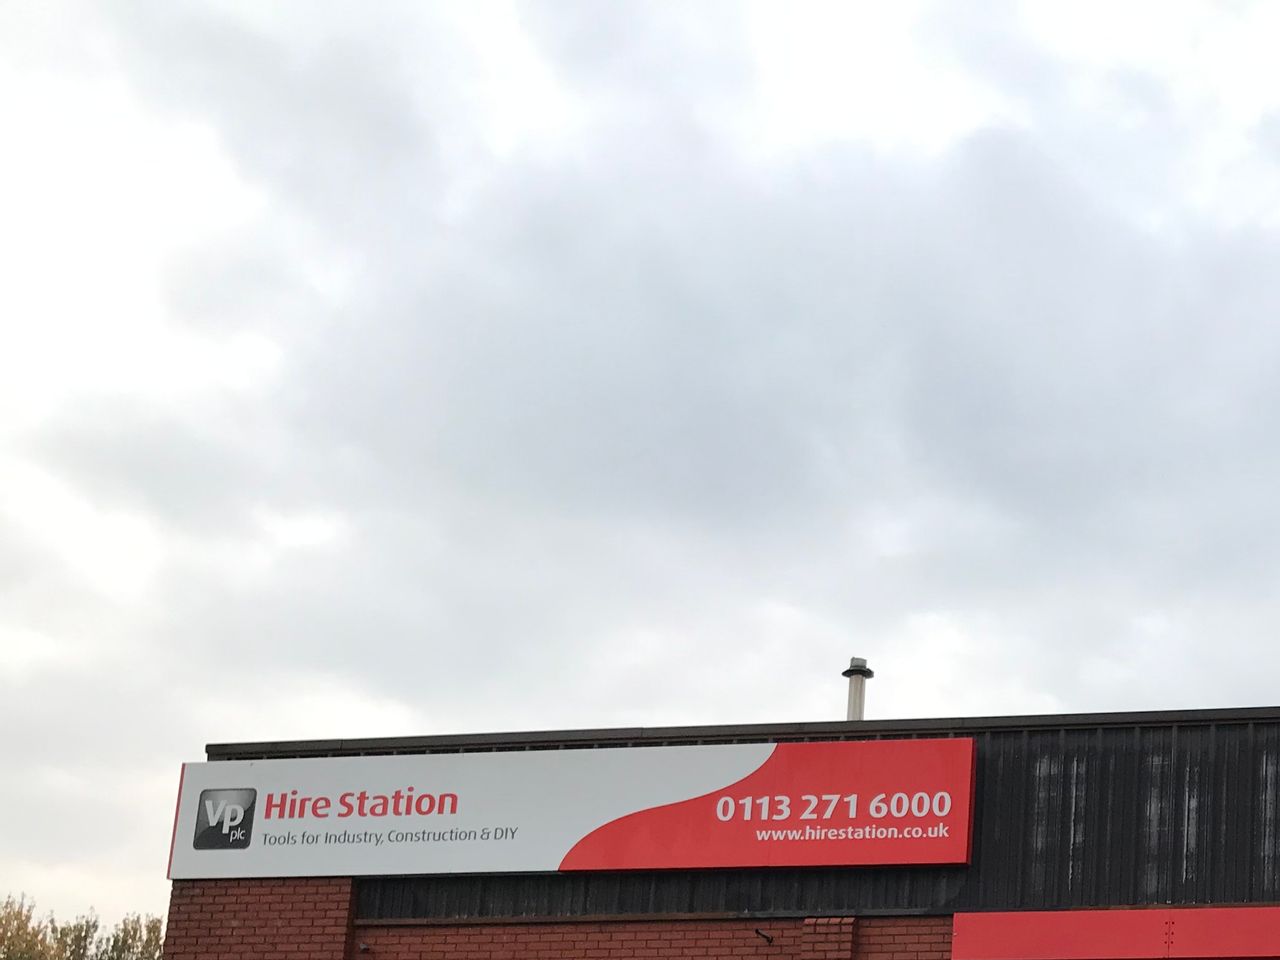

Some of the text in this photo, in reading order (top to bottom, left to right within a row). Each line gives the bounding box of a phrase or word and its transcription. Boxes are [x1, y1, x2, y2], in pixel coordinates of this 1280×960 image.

[264, 786, 459, 820] Hire Station
[716, 791, 952, 822] 0113 271 6000
[204, 799, 246, 834] Vp
[229, 827, 246, 843] plc
[262, 827, 519, 847] Tools for Industry, Construction & DIY
[756, 823, 950, 841] www.hirestation.co.uk
